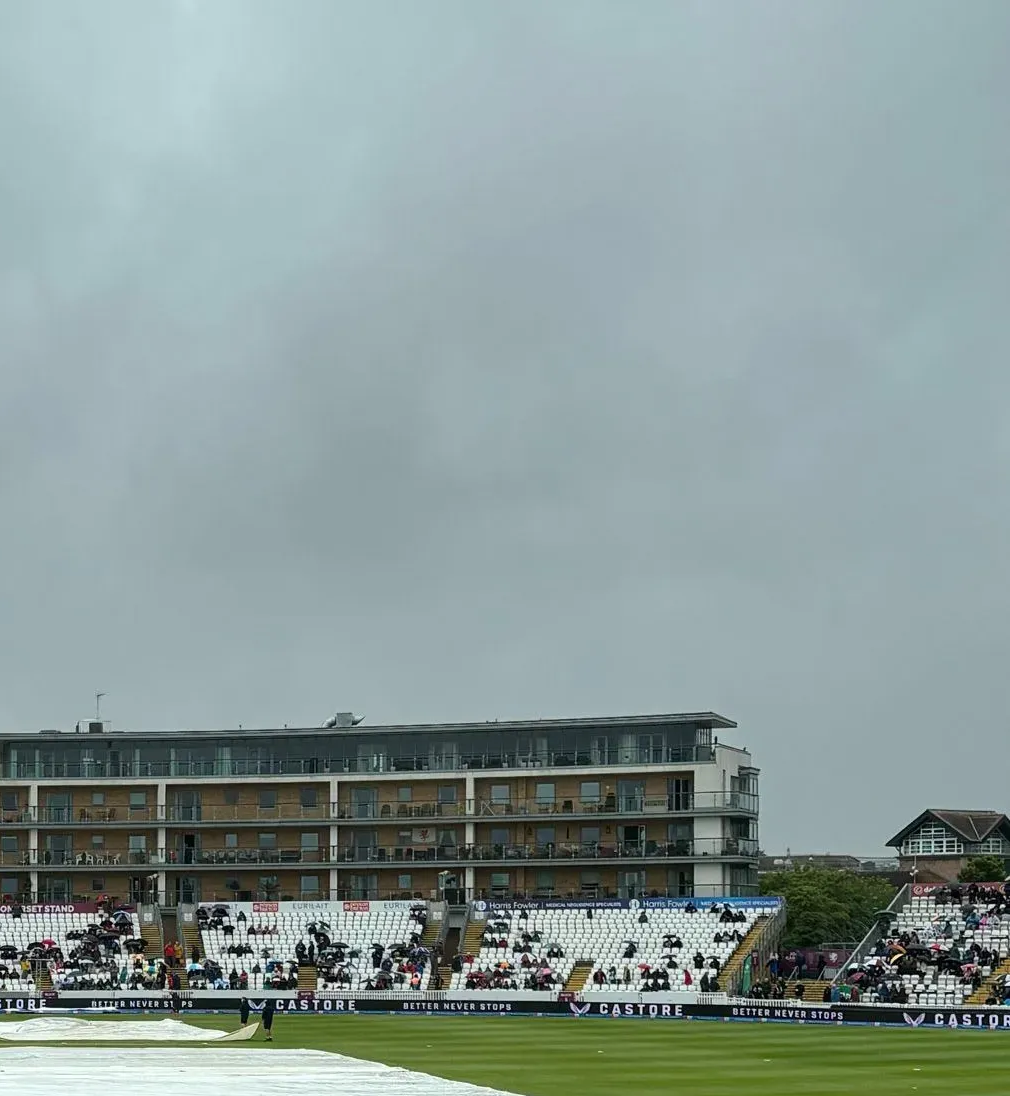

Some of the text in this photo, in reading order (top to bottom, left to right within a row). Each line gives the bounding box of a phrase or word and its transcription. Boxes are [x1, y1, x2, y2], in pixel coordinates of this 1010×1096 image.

[44, 905, 75, 913] STAND
[489, 901, 512, 909] Harris
[513, 901, 539, 909] Fowler
[91, 1000, 125, 1008] BETTER
[130, 1000, 159, 1008] NEVER
[275, 1000, 512, 1011] CASTORE BETTER NEVER STOPS
[599, 1003, 844, 1019] CASTORE BETTER NEVER STOPS
